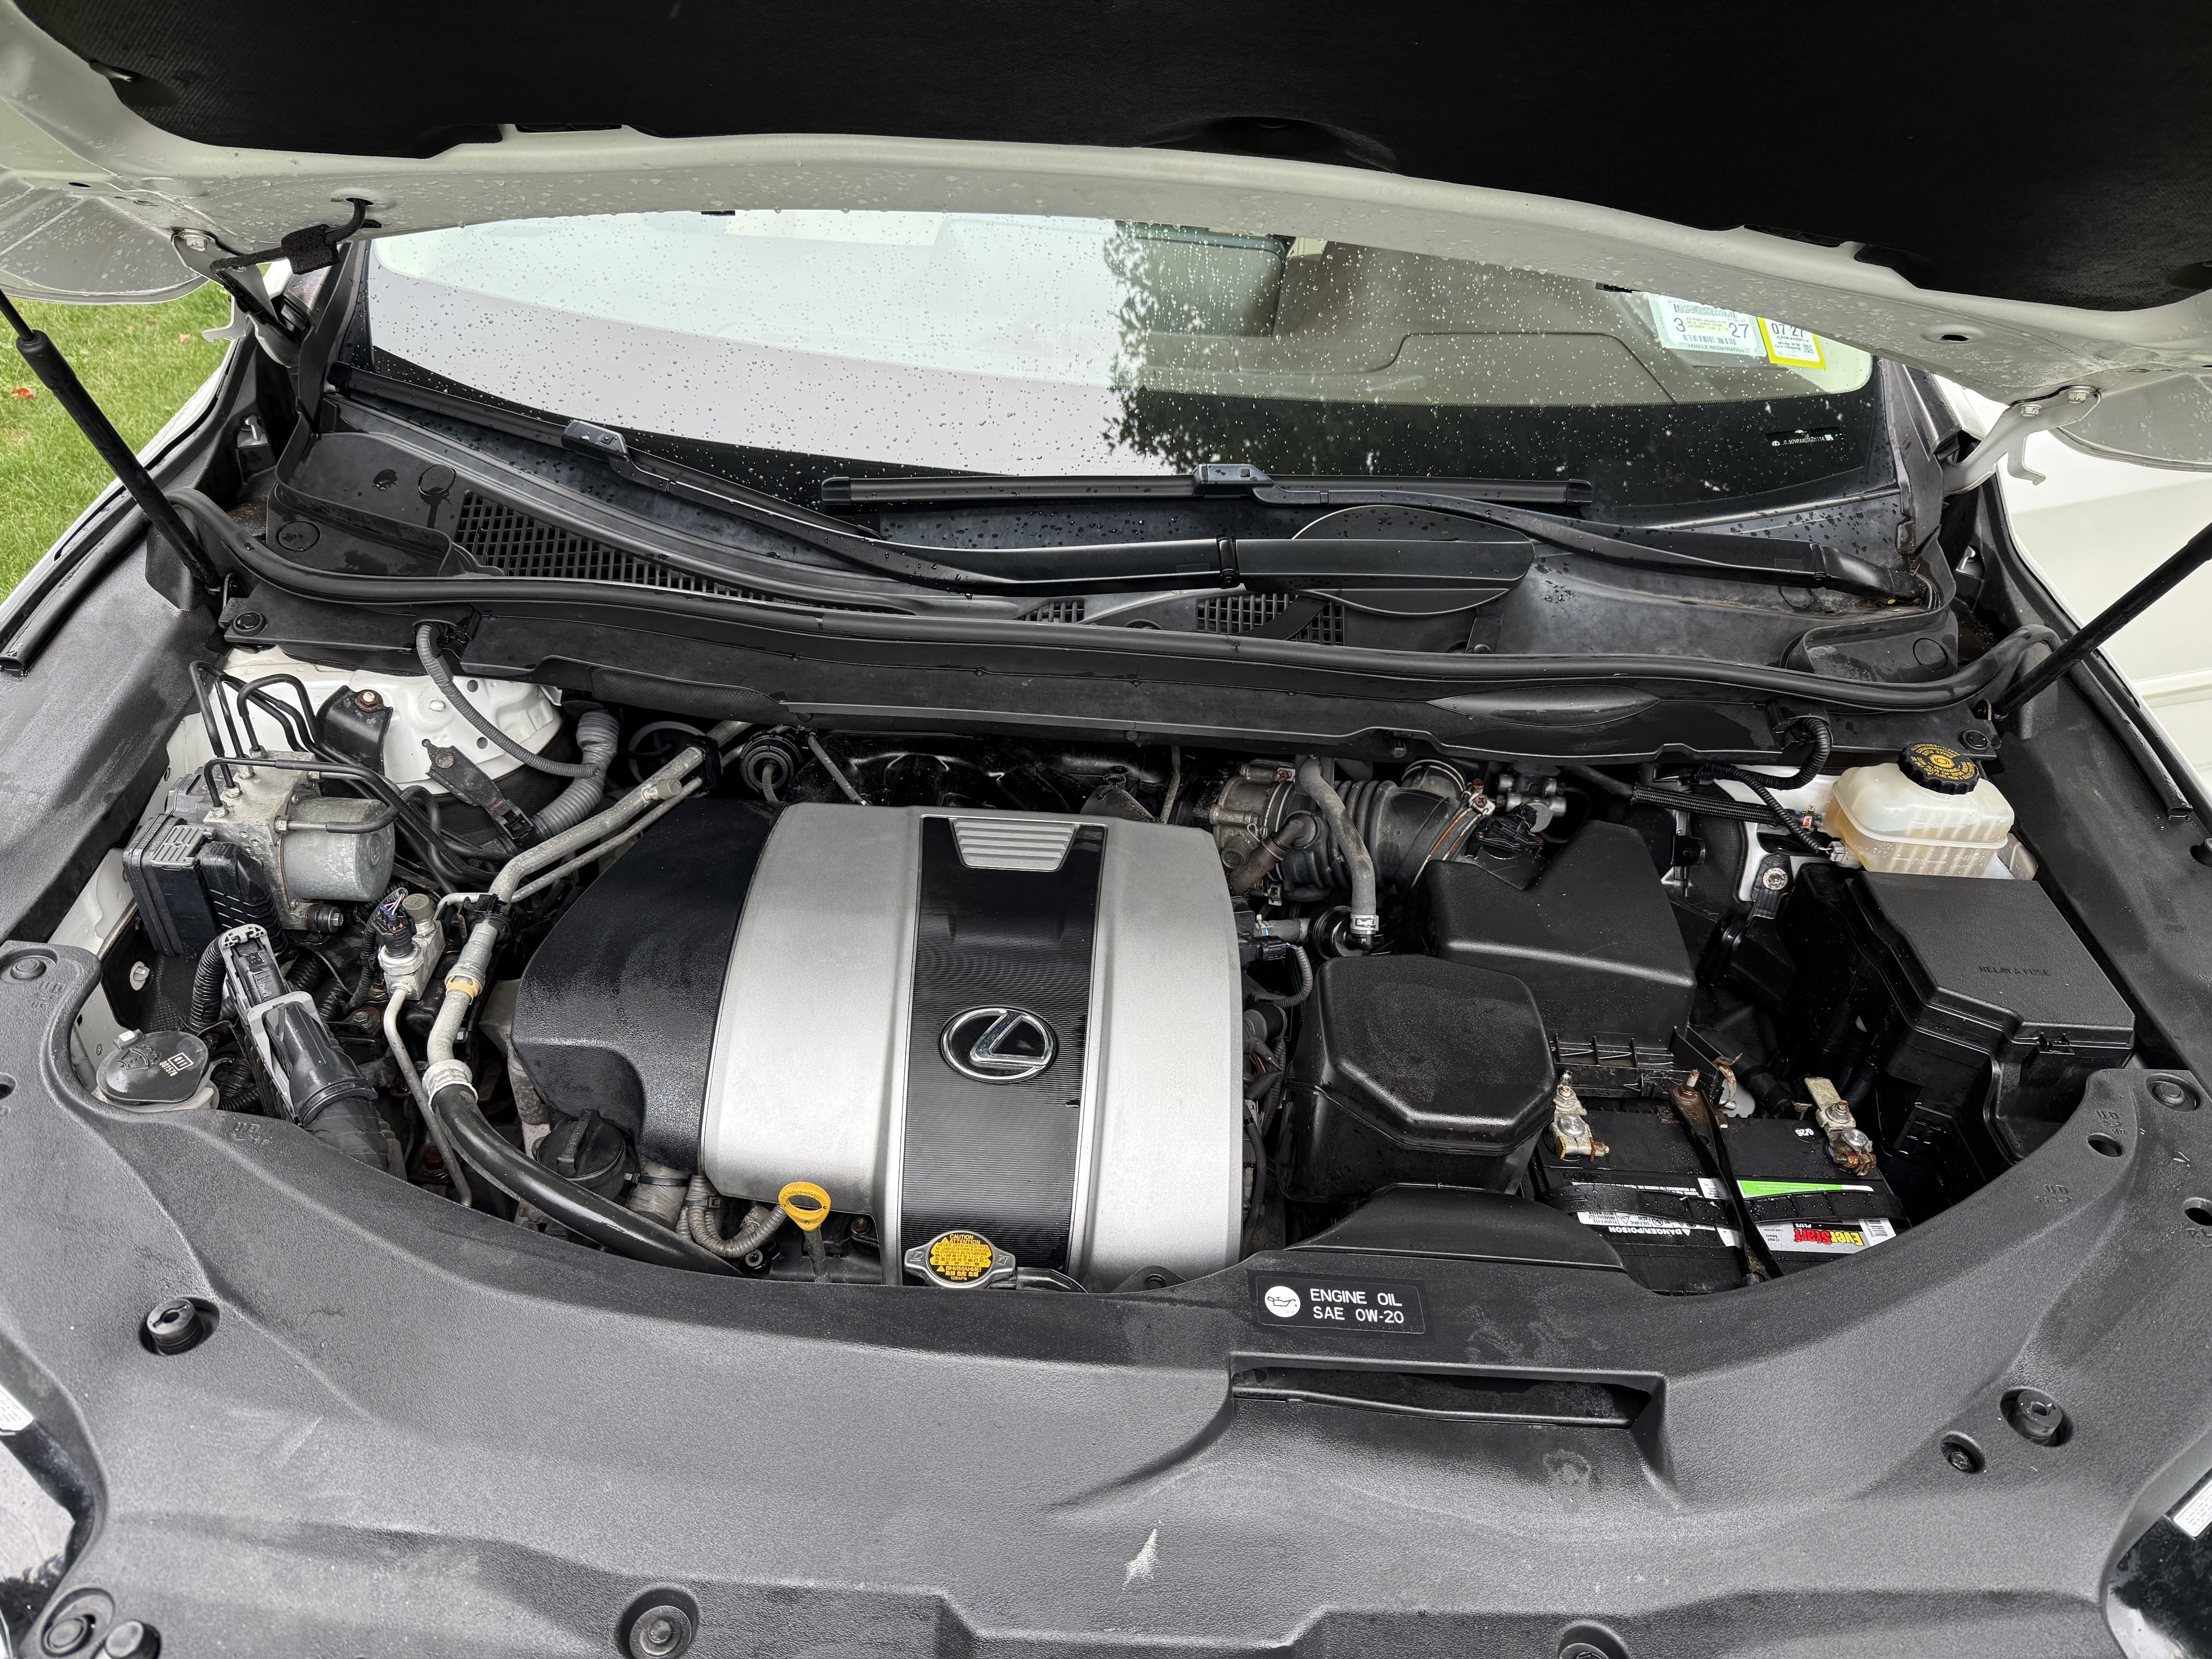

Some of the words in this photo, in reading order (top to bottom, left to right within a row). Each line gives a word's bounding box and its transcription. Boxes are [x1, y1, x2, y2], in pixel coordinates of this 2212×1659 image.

[1674, 318, 1685, 332] 3
[1729, 322, 1748, 338] 27
[1708, 345, 1744, 353] REGISTRATION
[781, 1190, 806, 1200] ENGINE
[1608, 1226, 1682, 1235] DANGER/POISON
[1793, 1228, 1864, 1246] EverStart
[1310, 1288, 1367, 1305] ENGINE
[1377, 1292, 1403, 1307] OIL
[1313, 1305, 1345, 1321] SAE
